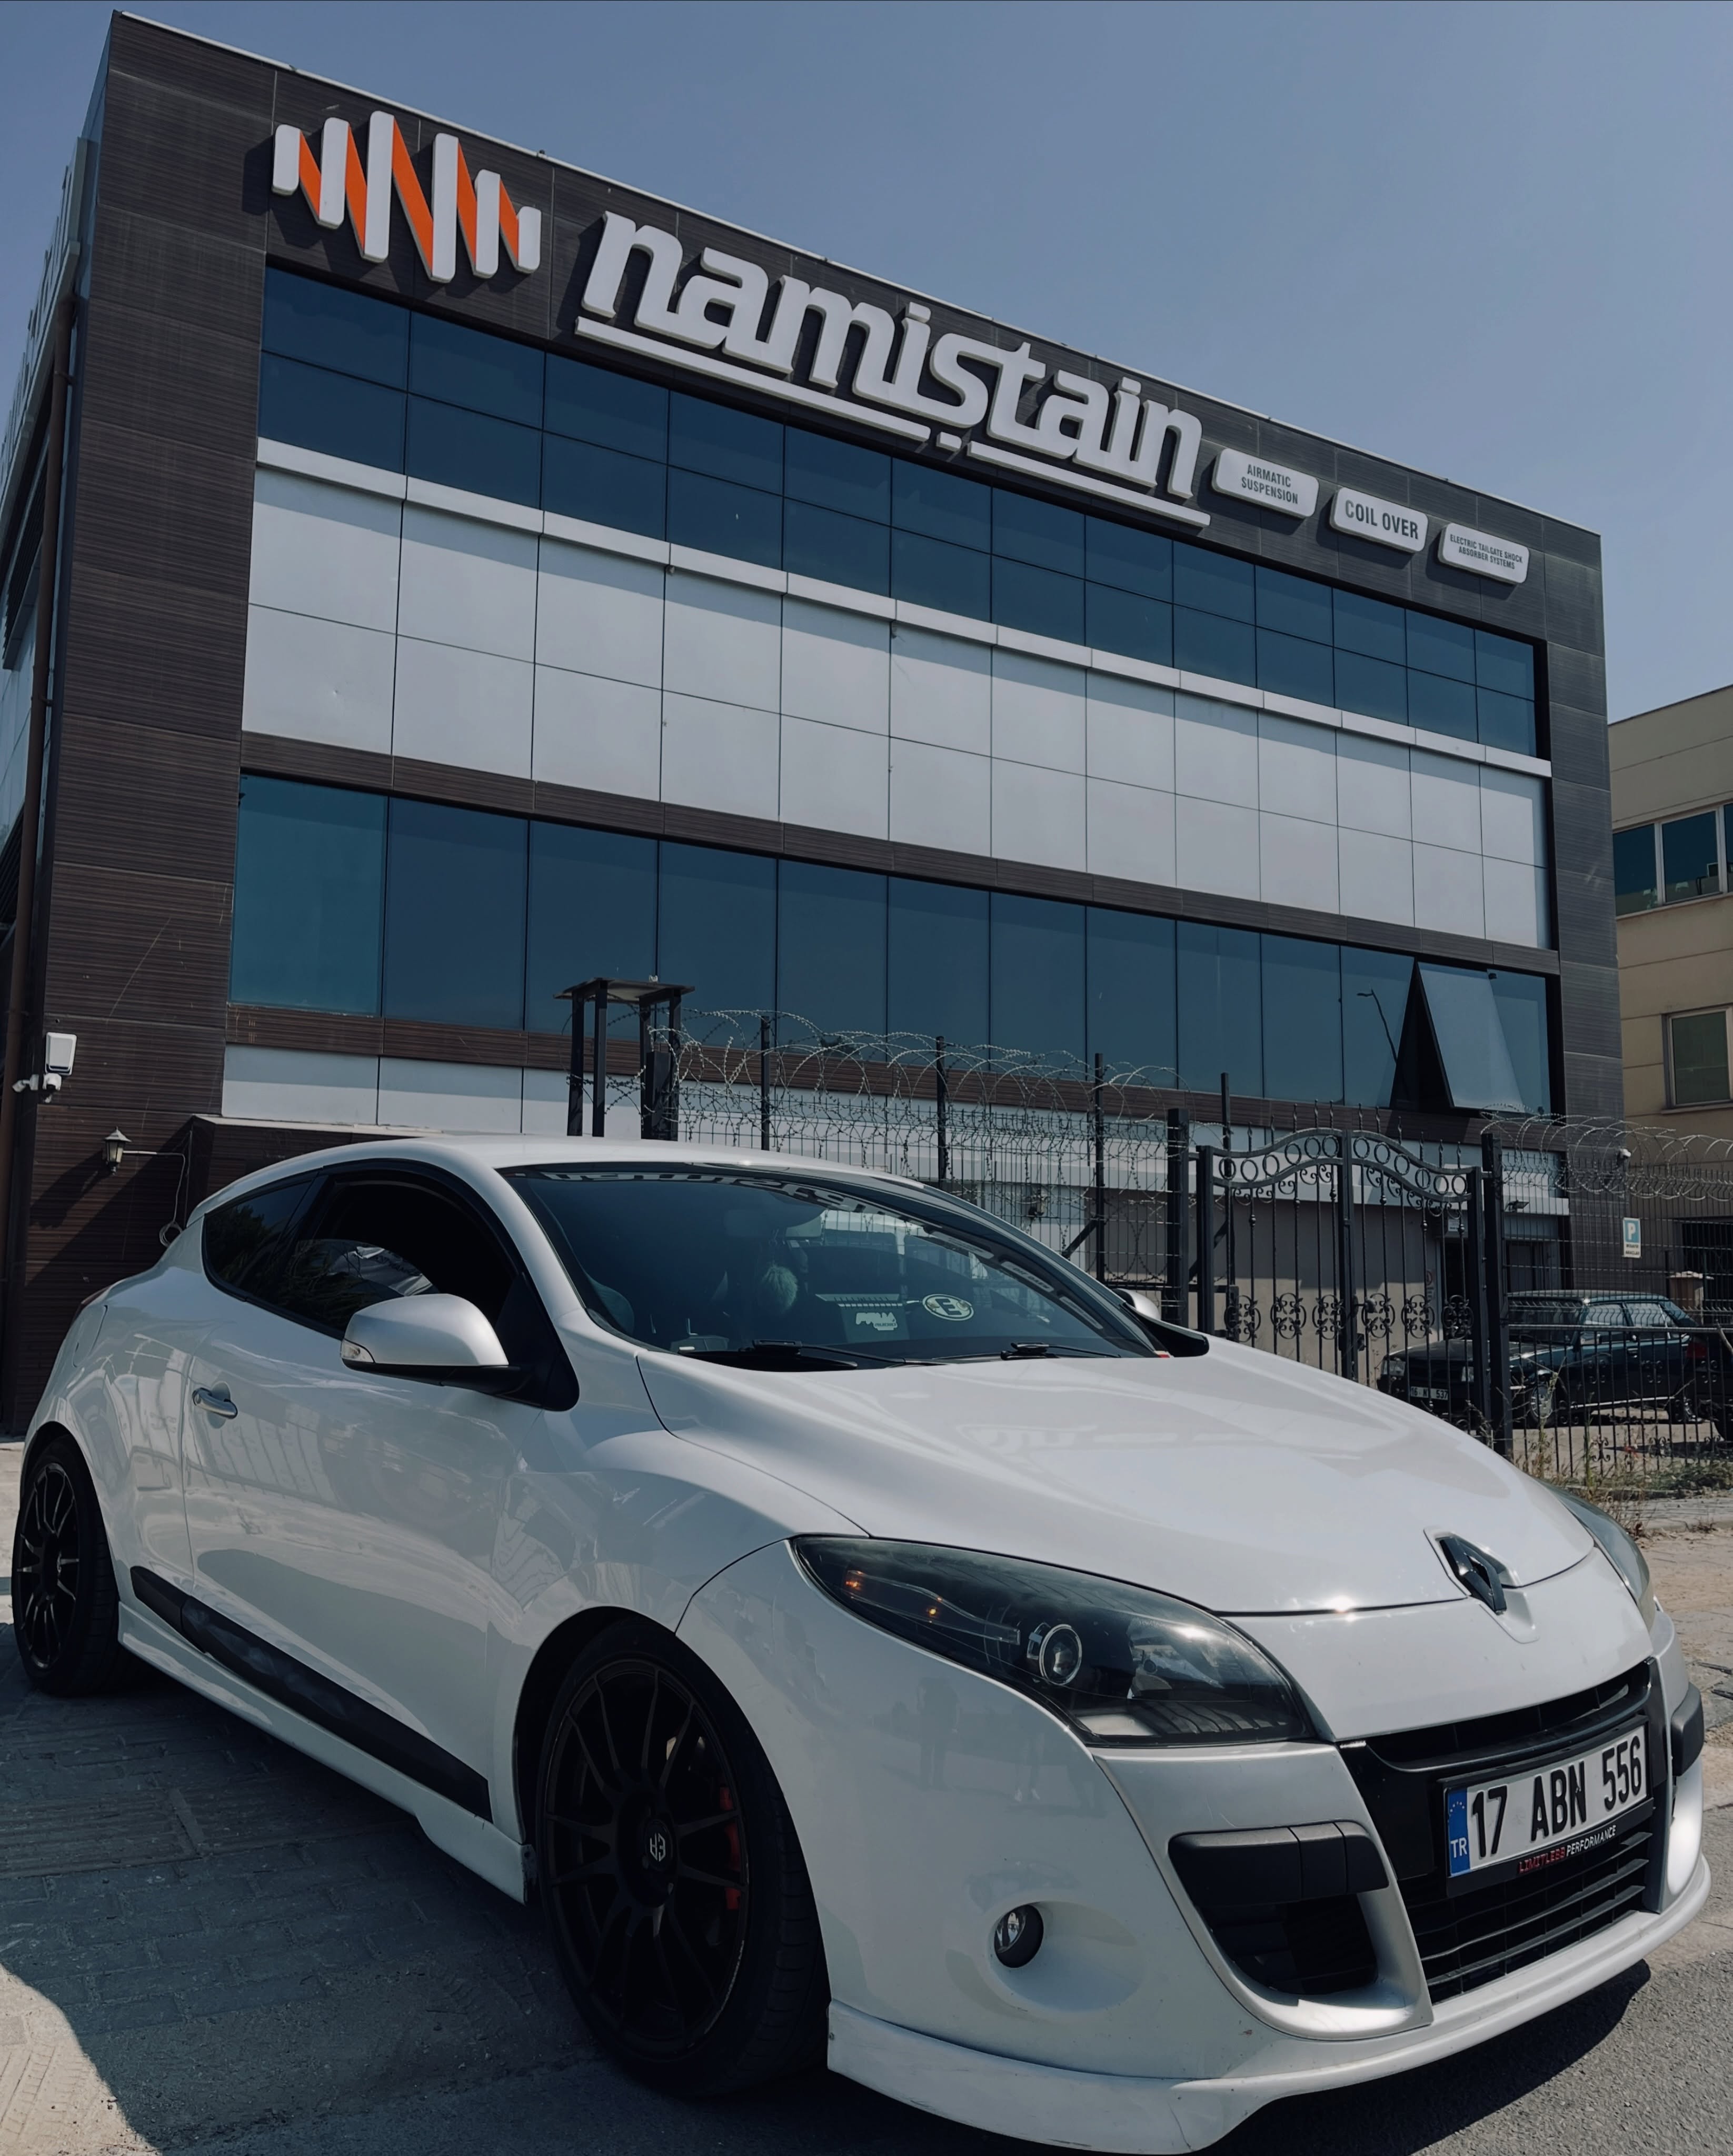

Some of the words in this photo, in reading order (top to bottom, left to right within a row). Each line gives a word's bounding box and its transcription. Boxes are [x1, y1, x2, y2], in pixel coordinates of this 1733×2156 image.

[1247, 464, 1291, 487] AIRMATIC
[1241, 476, 1298, 504] SUSPENSION
[1345, 500, 1378, 526] COIL
[1382, 512, 1419, 545] OVER
[1450, 534, 1477, 549] ELECTRIC
[1478, 543, 1503, 557] TAILGATE
[1504, 551, 1523, 564] SHOCK
[1459, 546, 1489, 561] ABSORBER
[1490, 555, 1515, 570] SYSTEMS
[1627, 1223, 1636, 1240] P
[1411, 1388, 1418, 1396] 16
[1436, 1390, 1449, 1399] 537
[1472, 1785, 1508, 1858] 17
[1531, 1760, 1587, 1842] ABN
[1601, 1735, 1642, 1811] 556
[1450, 1836, 1468, 1859] TR
[1566, 1824, 1617, 1857] PERFORMANCE
